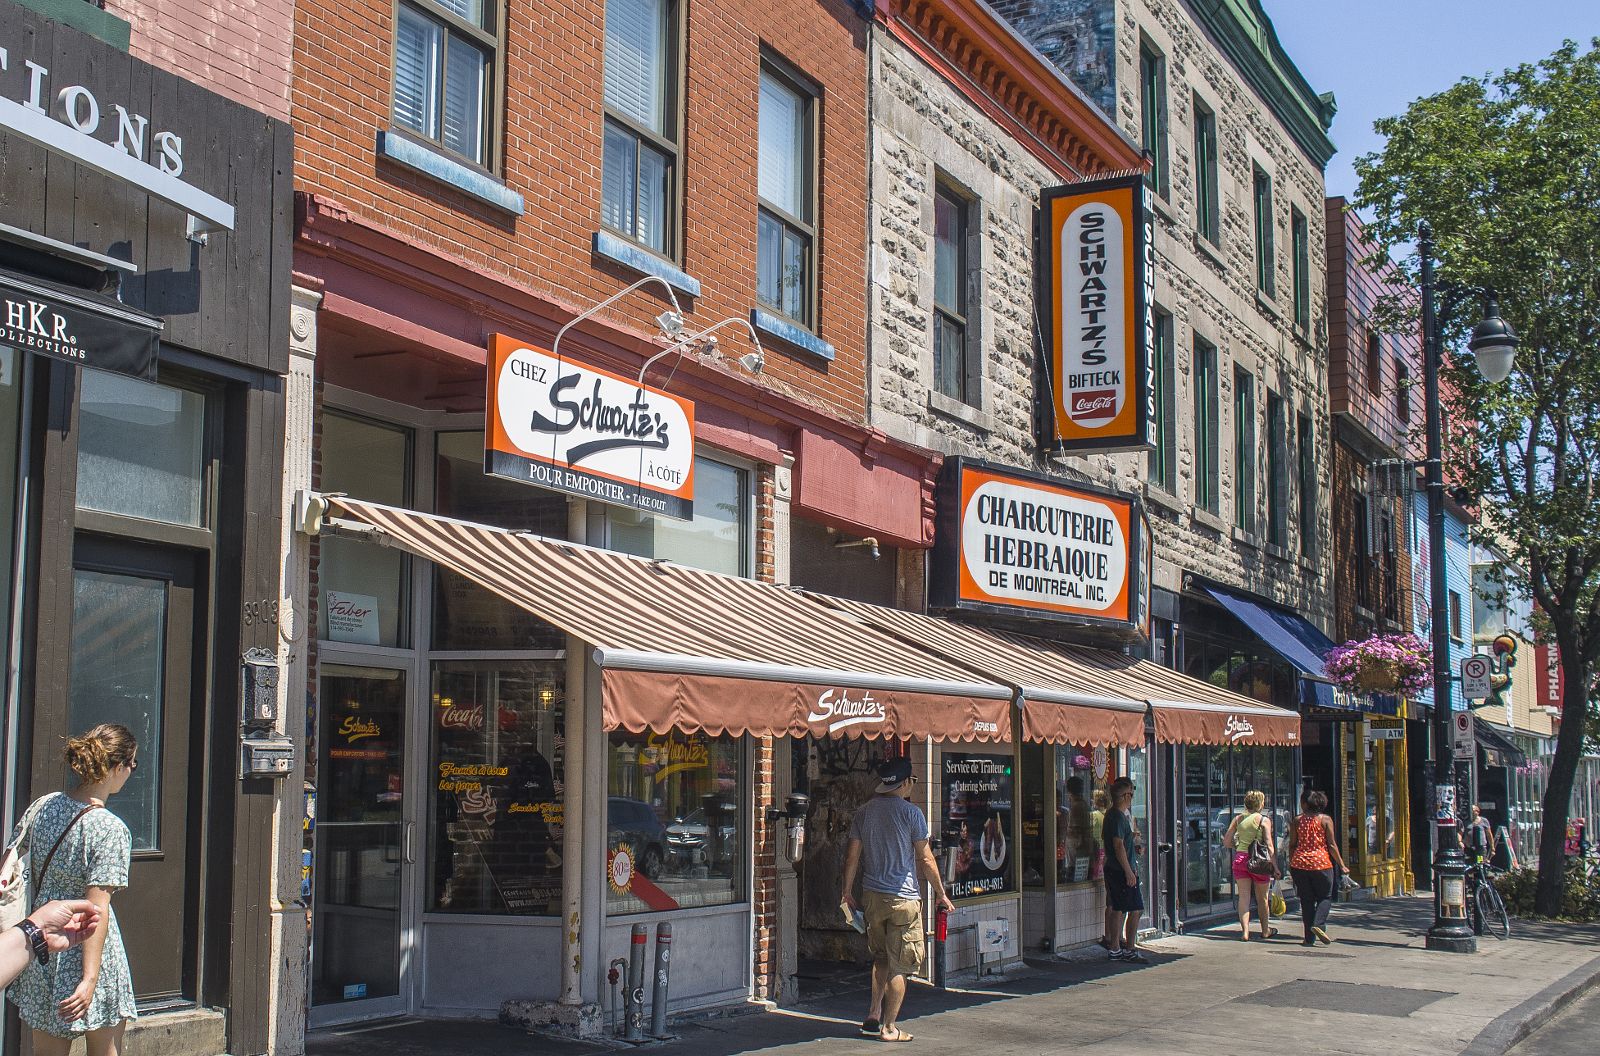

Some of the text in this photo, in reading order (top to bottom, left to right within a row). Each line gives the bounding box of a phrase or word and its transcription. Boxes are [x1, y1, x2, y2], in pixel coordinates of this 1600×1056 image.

[1079, 212, 1107, 366] SCHWARTZ'S
[1143, 221, 1156, 417] SCHWARTZ'S
[510, 358, 548, 385] CHEZ
[1069, 370, 1121, 389] BIFTECK
[531, 372, 669, 452] Schwartz's
[528, 463, 563, 486] POUR
[565, 472, 625, 501] EMPORTER
[632, 493, 651, 507] TAKE
[651, 498, 666, 511] OUT
[647, 460, 682, 485] À CÔTÉ
[977, 493, 1114, 547] CHARCUTERIE
[984, 533, 1108, 582] HEBRAIQUE
[989, 570, 1008, 589] DE
[1085, 584, 1108, 603] INC.
[329, 601, 372, 618] Faber
[808, 688, 886, 728] Schwartz's
[1388, 729, 1403, 738] ATM
[946, 759, 1005, 774] Service de Traiteur
[955, 780, 998, 794] Catering Service
[613, 862, 624, 877] 80
